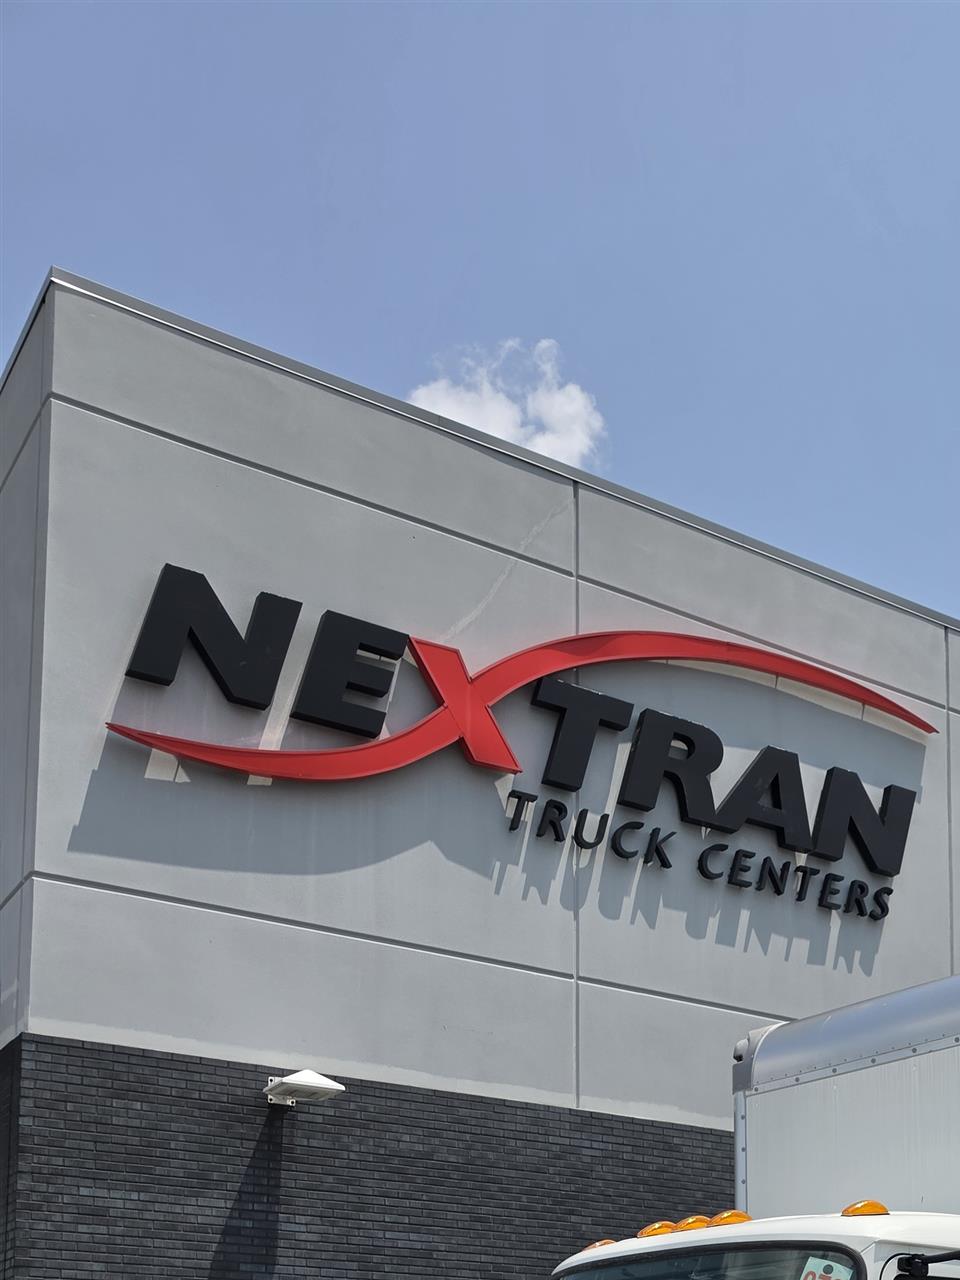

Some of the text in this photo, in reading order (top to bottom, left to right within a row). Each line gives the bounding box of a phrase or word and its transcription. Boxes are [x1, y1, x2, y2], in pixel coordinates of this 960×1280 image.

[106, 562, 938, 877] NEXTRAN
[508, 789, 894, 921] TRUCK CENTERS
